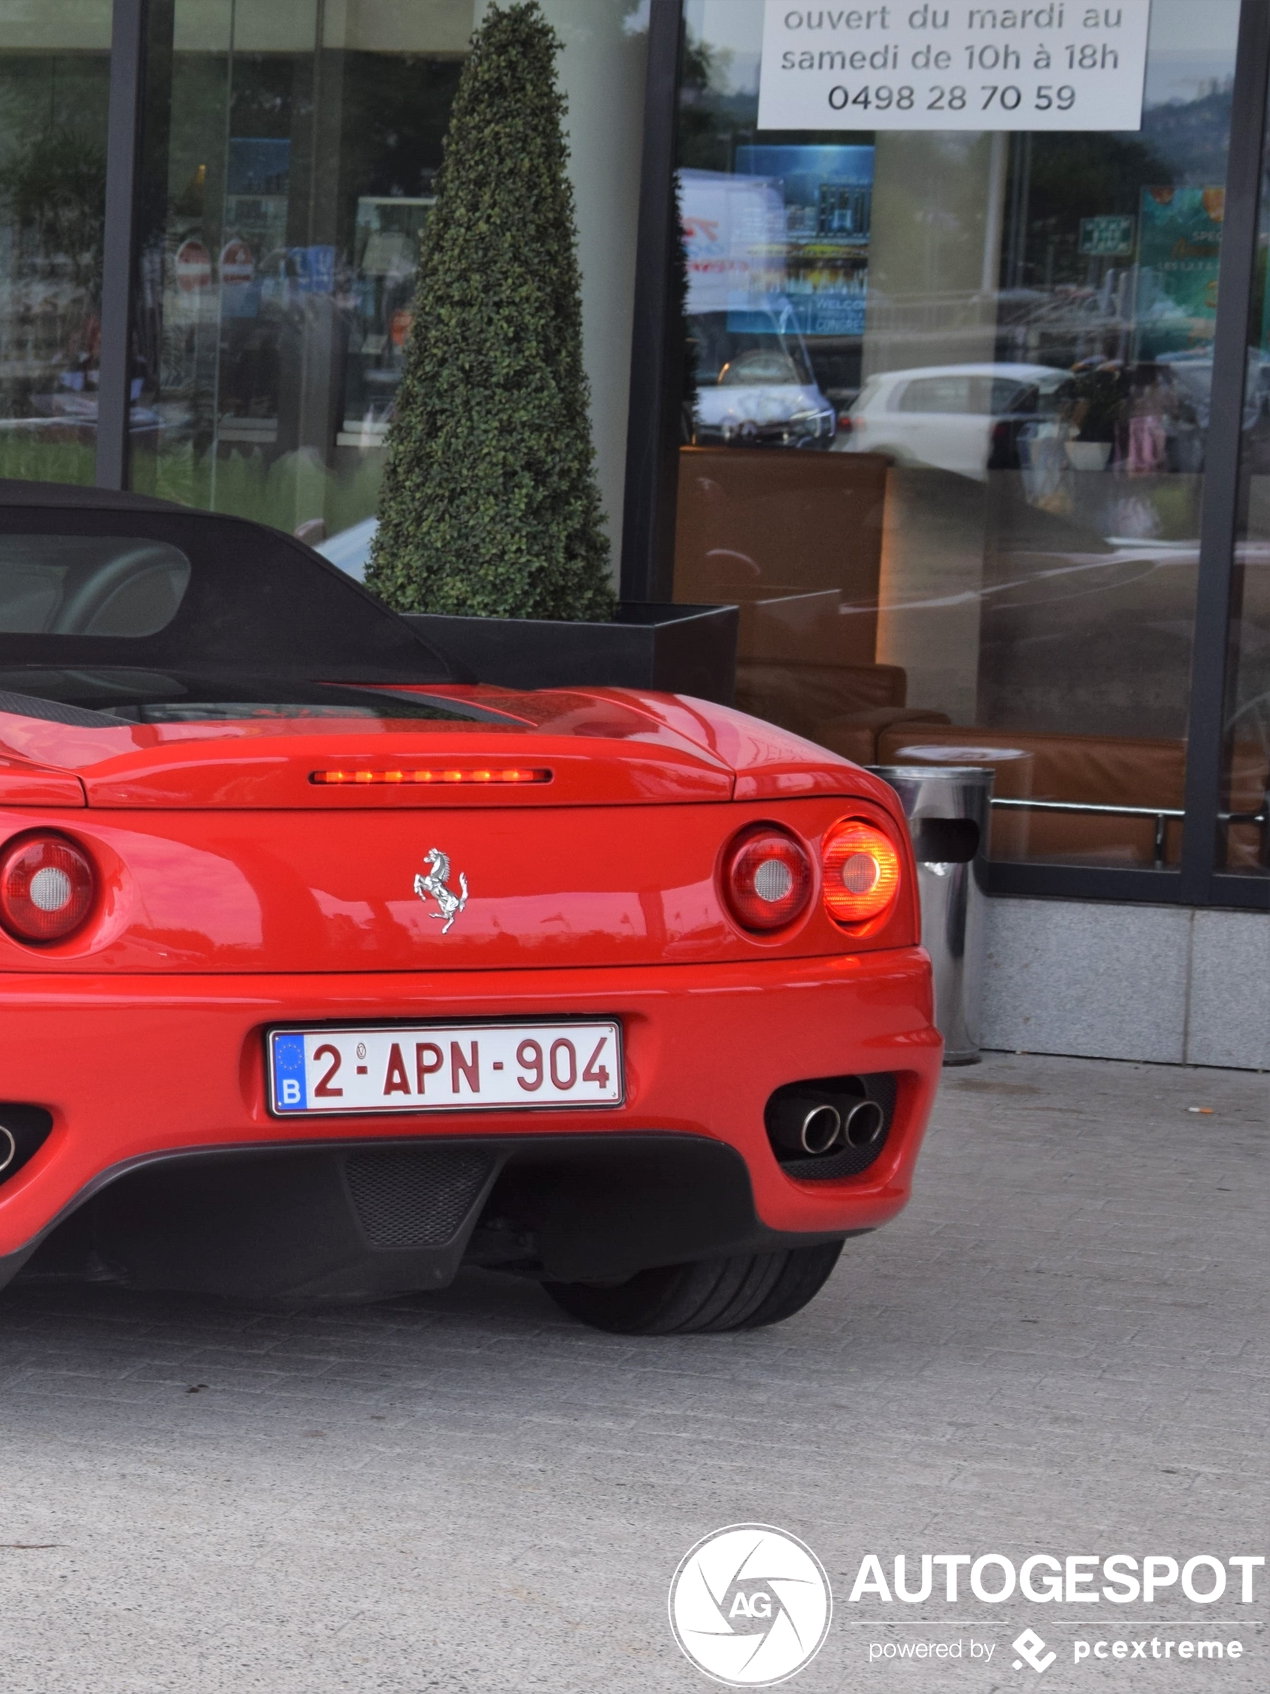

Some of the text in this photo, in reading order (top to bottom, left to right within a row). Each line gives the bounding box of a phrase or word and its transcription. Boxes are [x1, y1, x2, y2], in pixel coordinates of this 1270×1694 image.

[783, 2, 1123, 31] ouvert du mardi au
[780, 43, 1120, 71] samedi de 10h à 18h
[827, 84, 1077, 112] 0498 28 70 59
[312, 1036, 611, 1098] 2-APN-904
[282, 1079, 302, 1104] B
